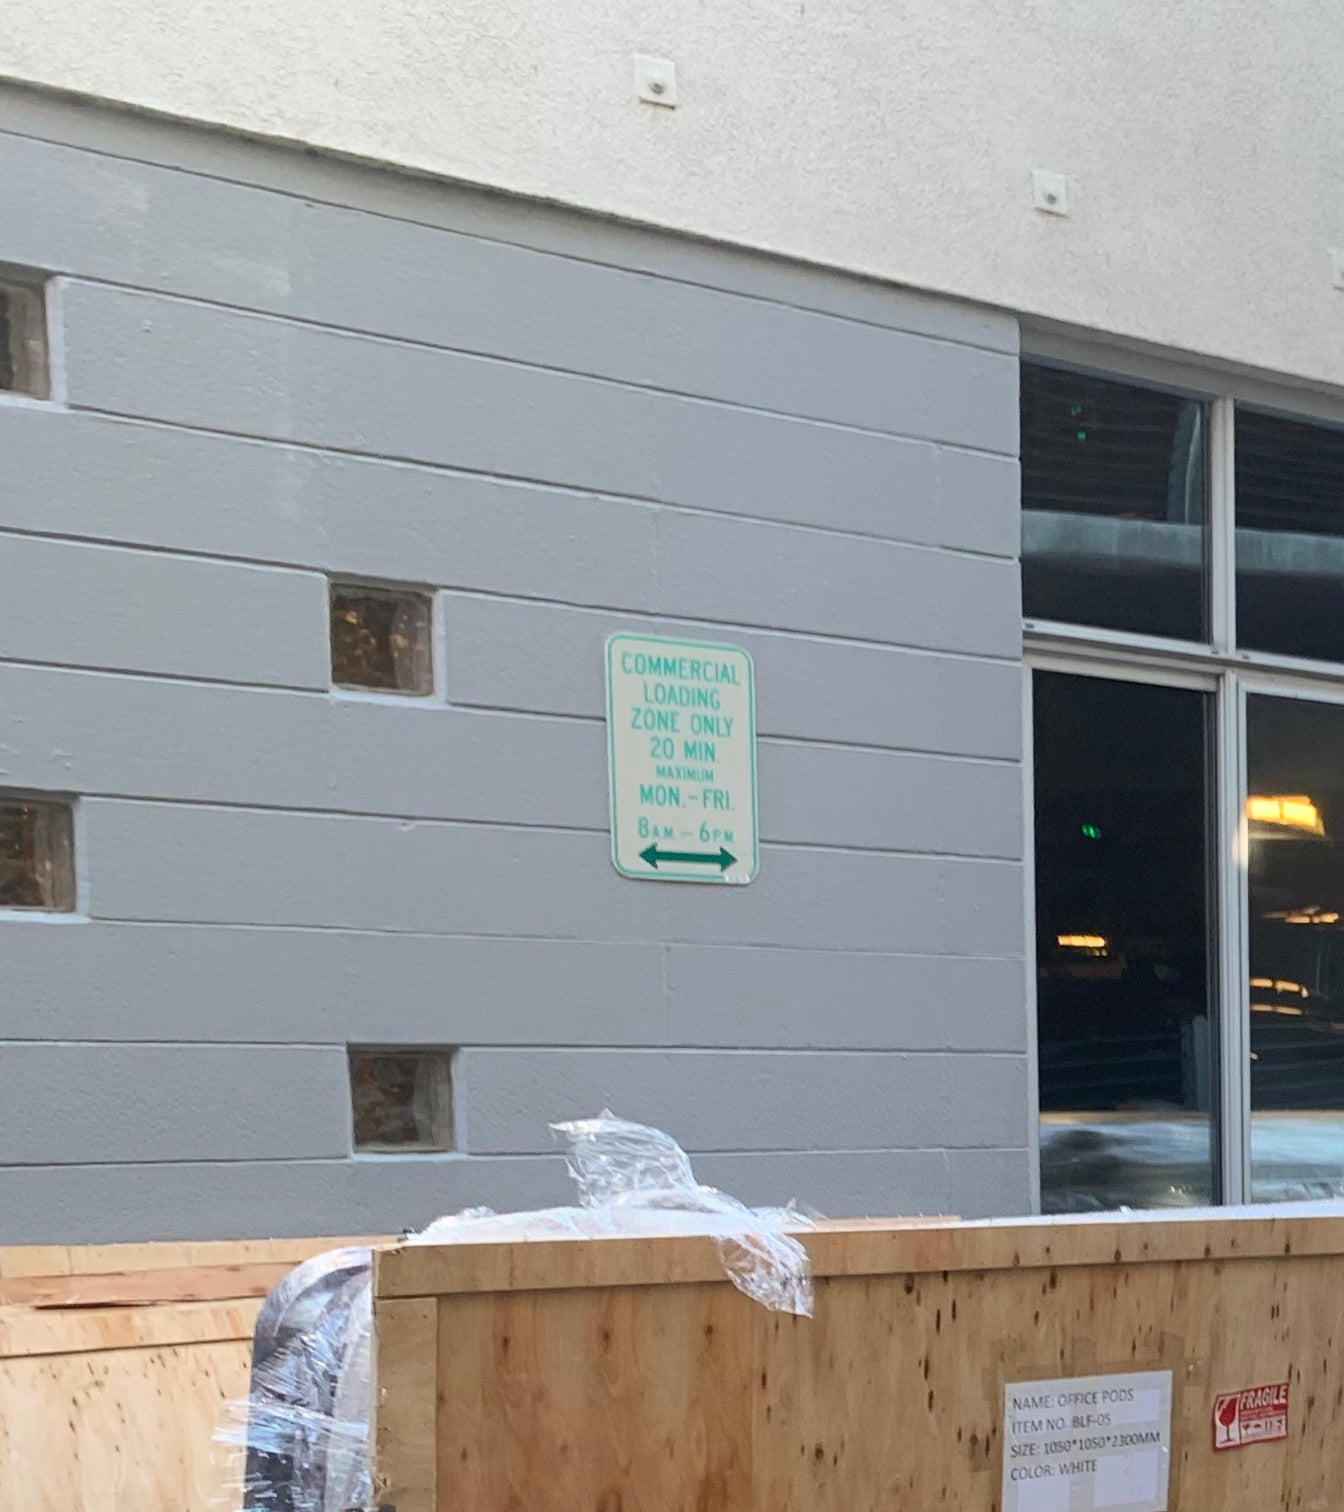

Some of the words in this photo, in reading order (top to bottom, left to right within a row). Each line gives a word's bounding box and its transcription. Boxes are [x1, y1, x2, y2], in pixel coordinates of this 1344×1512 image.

[621, 652, 741, 686] COMMERCIAL
[643, 680, 721, 710] LOADING
[630, 707, 681, 733] ZONE
[690, 713, 734, 738] ONLY
[650, 735, 675, 760] 20
[655, 764, 715, 783] MAXIMUM
[1012, 1395, 1055, 1411] NAME:
[1058, 1391, 1099, 1408] OFFICE
[1102, 1388, 1135, 1404] PODS
[1240, 1384, 1288, 1410] FRAGILE
[1012, 1419, 1044, 1434] ITEM
[1010, 1442, 1041, 1458] SIZE:
[1010, 1464, 1055, 1482] COLOR:
[1058, 1459, 1097, 1475] WHITE
